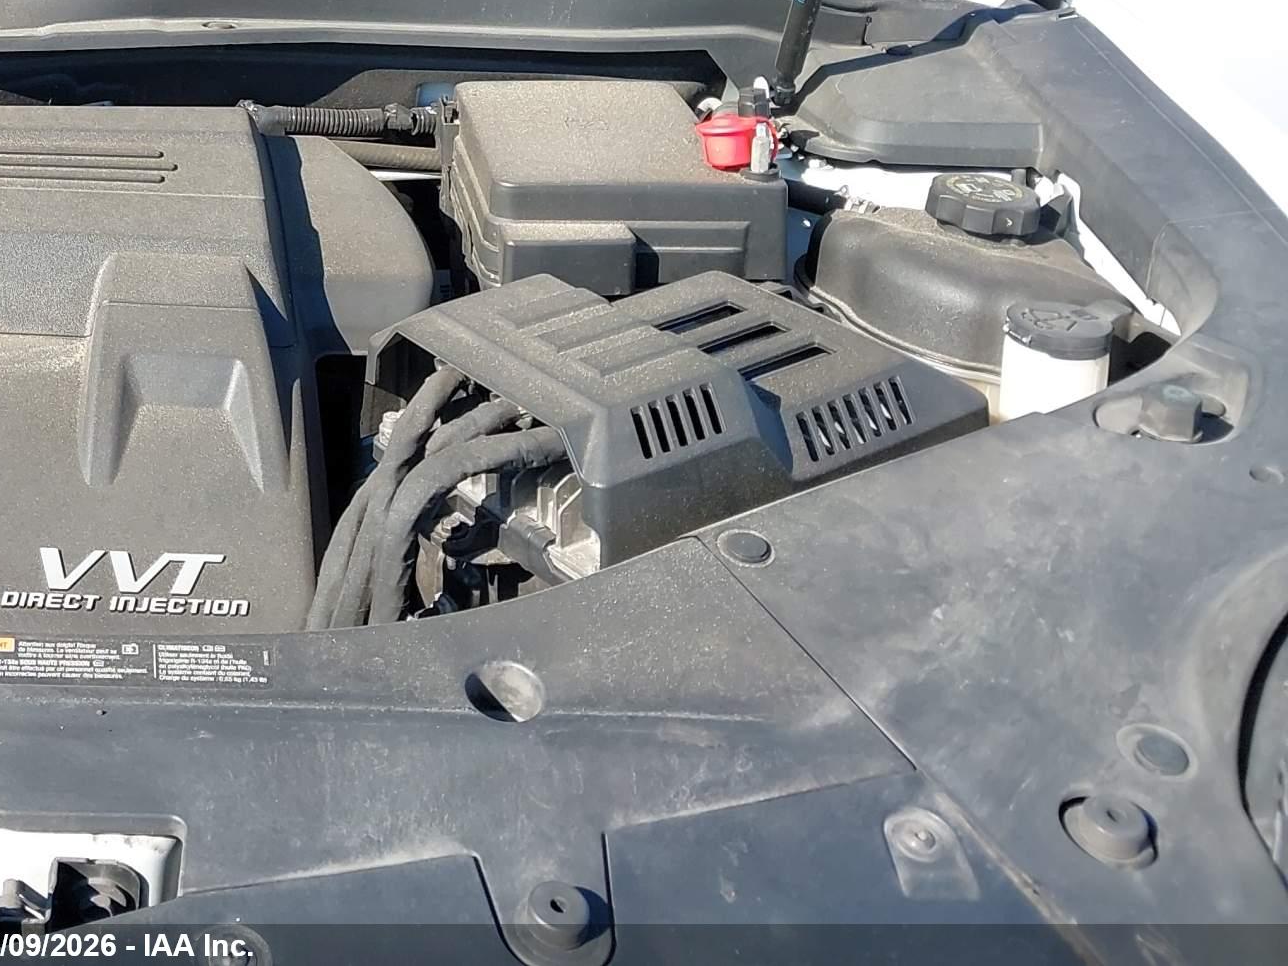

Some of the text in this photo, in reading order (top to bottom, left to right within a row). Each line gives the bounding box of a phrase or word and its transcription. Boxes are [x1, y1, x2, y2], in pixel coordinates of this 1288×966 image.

[39, 547, 226, 595] VVT
[1, 591, 251, 616] DIRECT INJECTION
